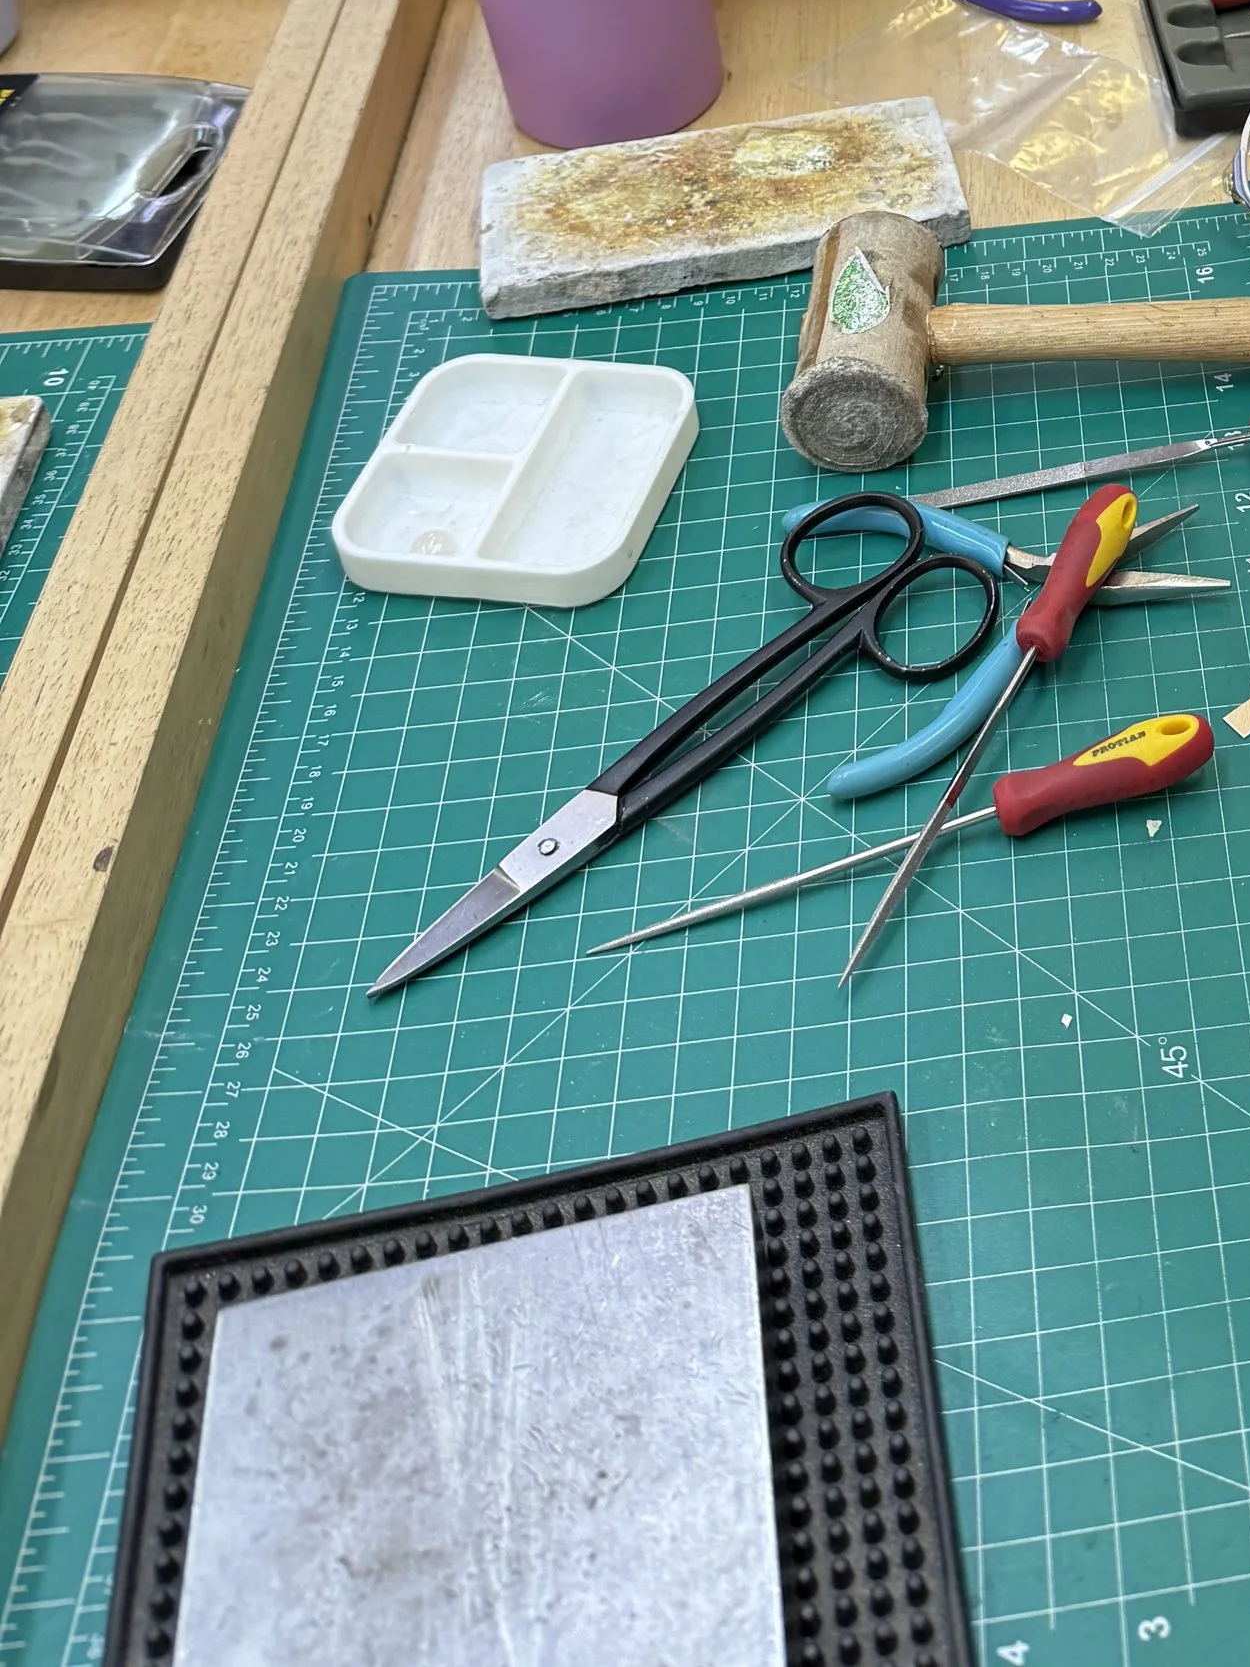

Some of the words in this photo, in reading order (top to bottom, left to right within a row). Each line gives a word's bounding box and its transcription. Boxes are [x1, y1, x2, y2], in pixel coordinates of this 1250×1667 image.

[1196, 247, 1208, 257] 25
[1104, 257, 1115, 267] 22
[1135, 254, 1146, 264] 23
[1043, 264, 1053, 274] 20
[1073, 261, 1084, 270] 21
[949, 274, 959, 282] 17
[980, 271, 990, 281] 18
[1011, 268, 1021, 277] 19
[1195, 266, 1215, 284] 16
[724, 295, 736, 305] 10
[757, 291, 768, 301] 11
[789, 289, 801, 299] 12
[43, 368, 70, 387] 10
[1215, 372, 1235, 393] 14
[87, 379, 101, 391] 40
[76, 401, 90, 413] 39
[66, 423, 80, 435] 38
[55, 447, 68, 458] 37
[44, 469, 58, 481] 36
[32, 494, 47, 506] 35
[20, 519, 35, 531] 34
[8, 544, 23, 556] 33
[352, 592, 366, 604] 12
[346, 619, 359, 631] 13
[338, 646, 352, 658] 14
[331, 675, 345, 687] 15
[323, 704, 337, 717] 16
[317, 734, 330, 746] 17
[1091, 730, 1147, 757] PROTIAN
[308, 765, 322, 778] 18
[300, 796, 314, 810] 19
[292, 828, 307, 843] 20
[284, 861, 298, 876] 21
[274, 895, 290, 911] 22
[265, 931, 281, 947] 23
[256, 967, 271, 983] 24
[246, 1004, 262, 1021] 25
[235, 1042, 251, 1059] 26
[1158, 1036, 1189, 1079] 45°
[226, 1081, 241, 1098] 27
[213, 1121, 231, 1139] 28
[202, 1161, 219, 1181] 29
[189, 1205, 207, 1224] 30
[1137, 1615, 1172, 1641] 3
[996, 1639, 1030, 1667] 4
